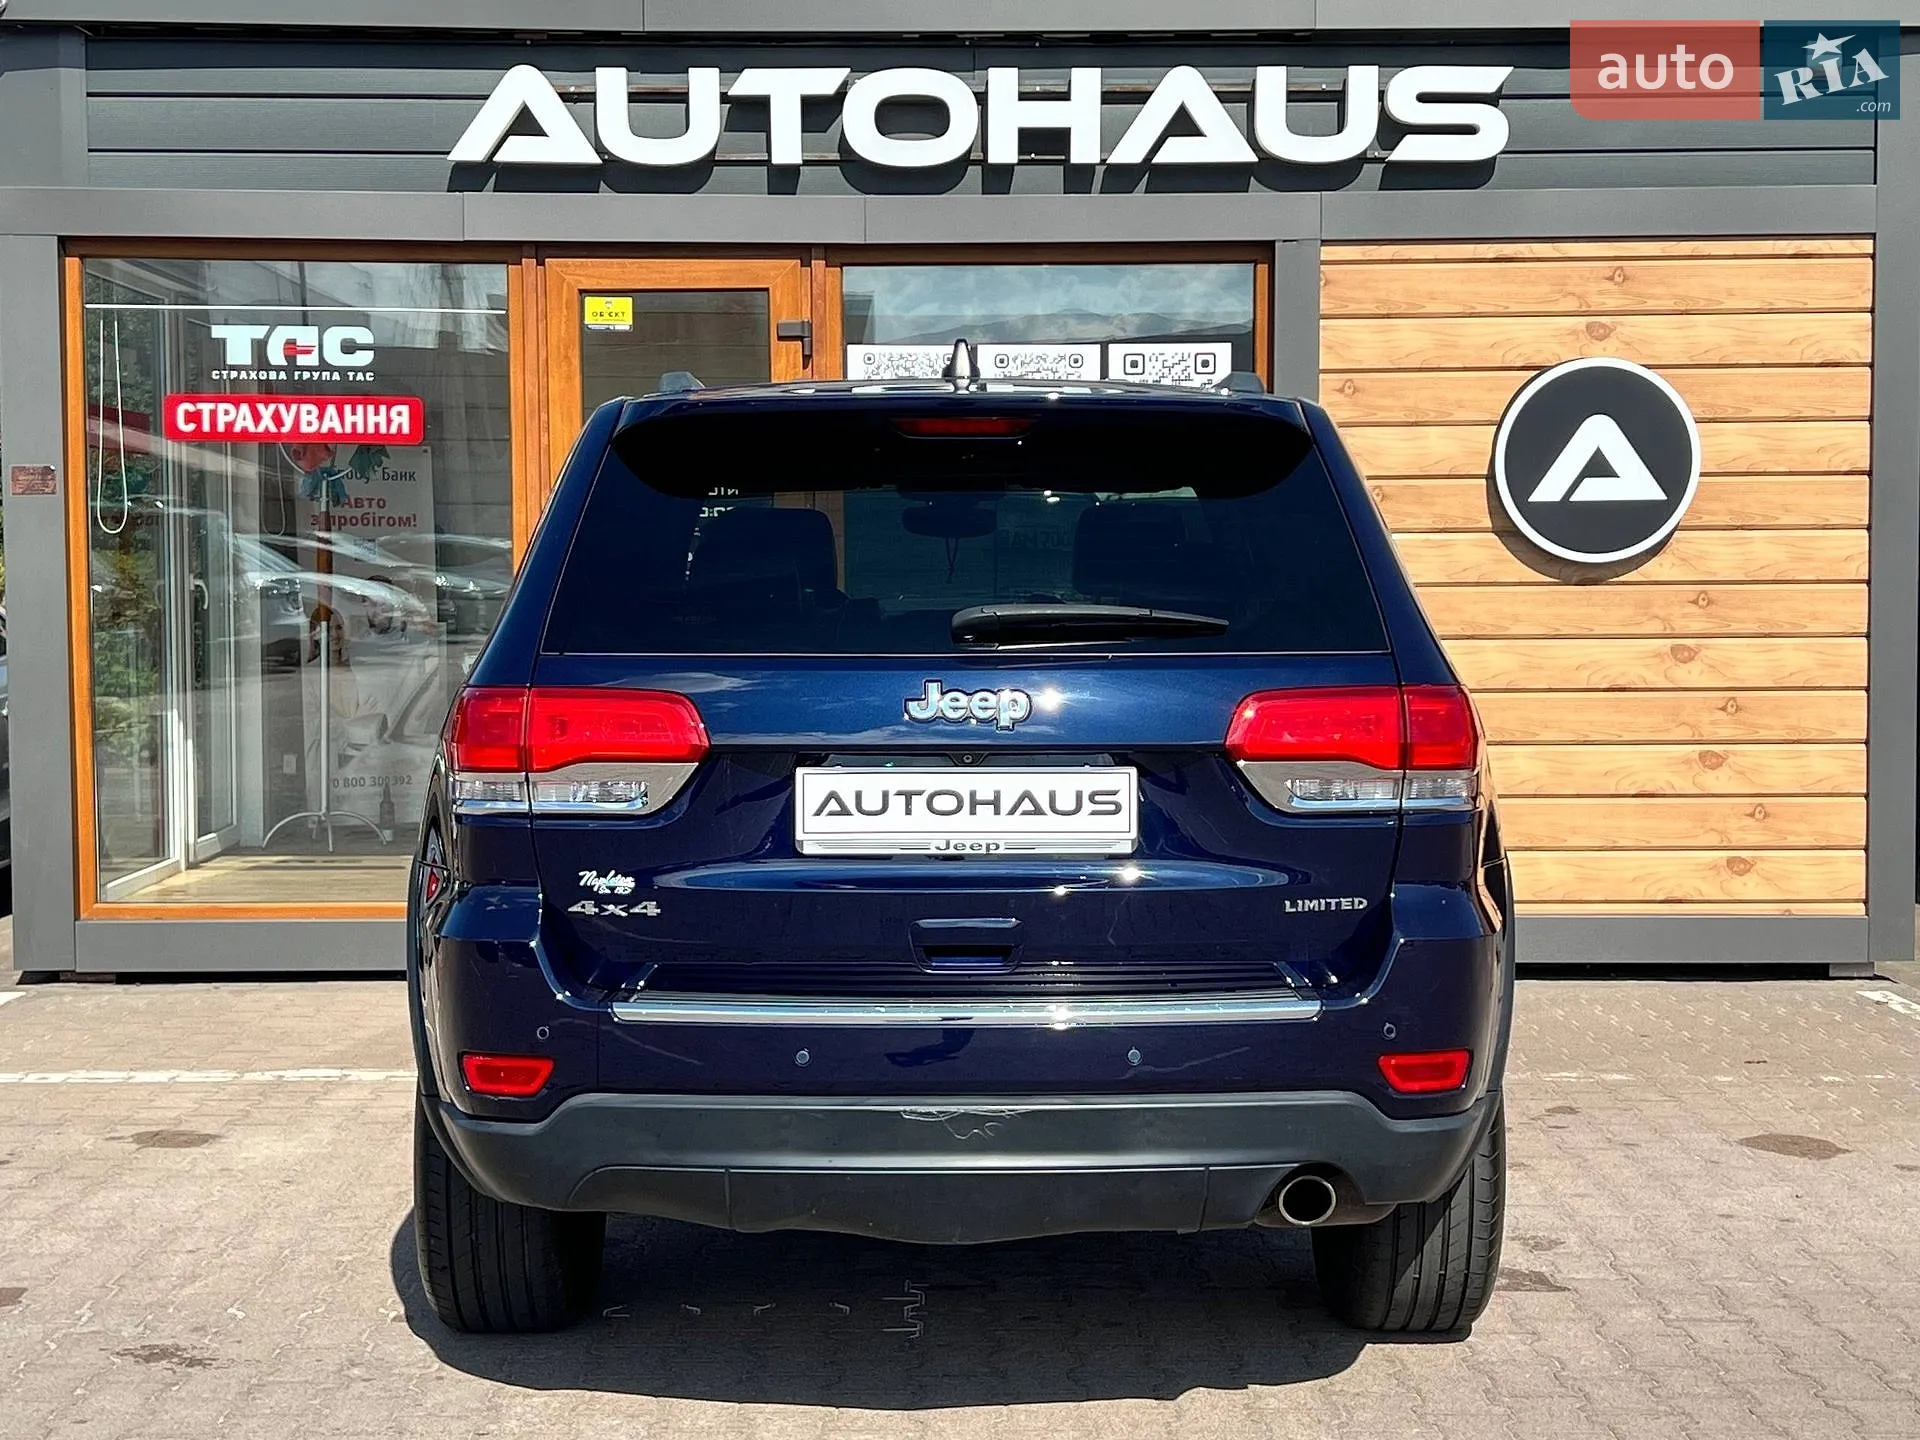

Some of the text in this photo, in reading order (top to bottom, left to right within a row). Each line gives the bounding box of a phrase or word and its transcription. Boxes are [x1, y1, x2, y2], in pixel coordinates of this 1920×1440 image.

[447, 64, 1514, 167] AUTOHAUS
[211, 325, 375, 367] ТАС
[211, 370, 375, 383] СТРАХОВА ГРУПА ТАС
[176, 402, 411, 435] СТРАХУВАННЯ
[1527, 413, 1668, 503] A
[382, 467, 416, 482] Банк
[331, 512, 417, 531] пробігом!
[904, 680, 1033, 732] Jeep
[332, 778, 340, 789] 0
[343, 776, 366, 789] 800
[811, 788, 1124, 817] AUTOHAUS
[935, 840, 1001, 855] Jeep
[1284, 897, 1368, 913] LIMITED
